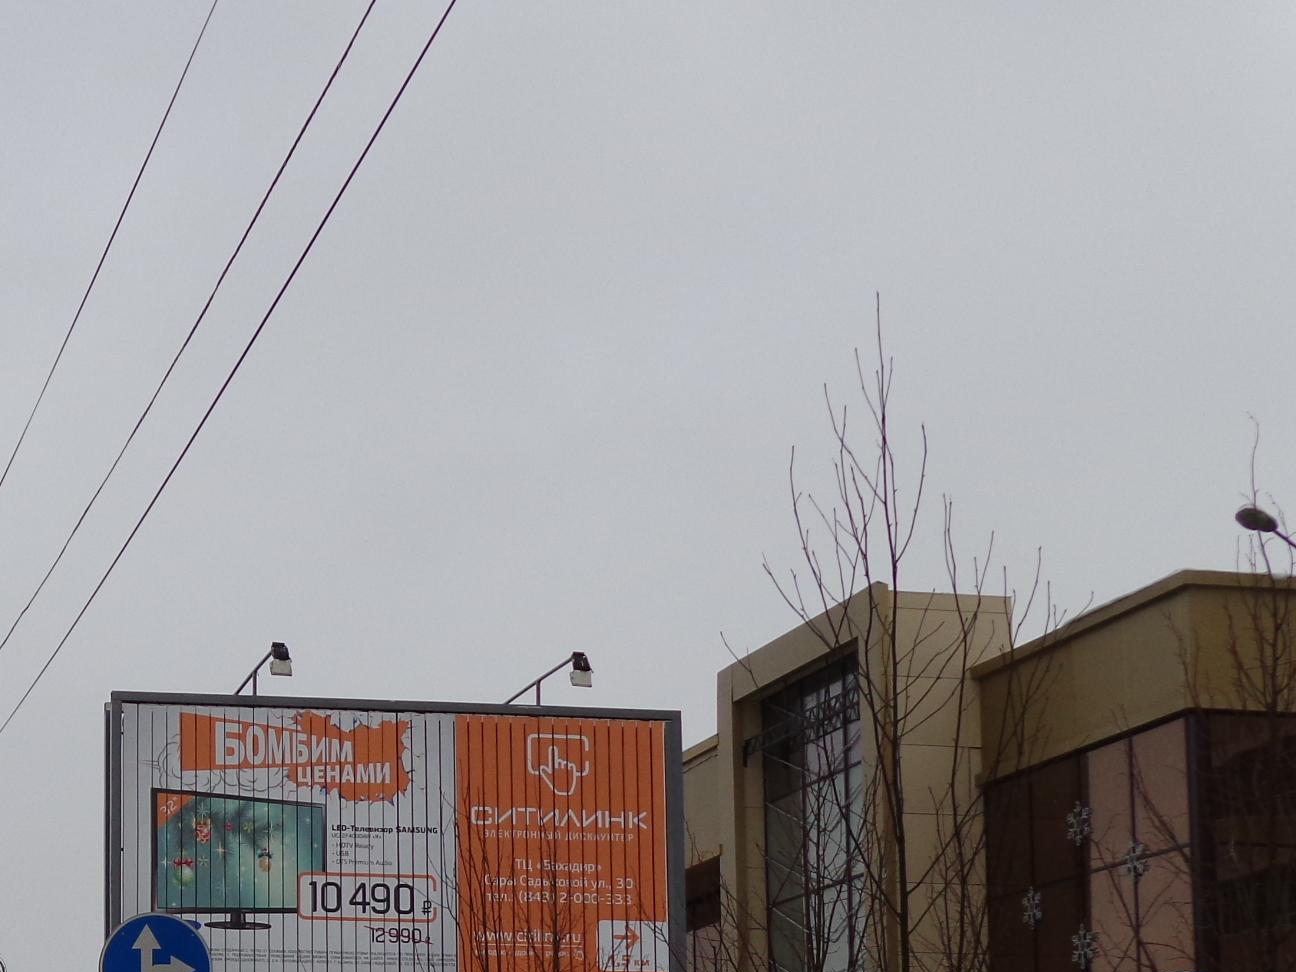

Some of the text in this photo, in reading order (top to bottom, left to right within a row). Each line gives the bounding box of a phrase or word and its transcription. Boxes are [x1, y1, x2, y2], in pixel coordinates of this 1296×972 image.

[215, 721, 353, 766] БОМБИМ
[297, 762, 391, 786] ЦЕНАМИ
[470, 805, 648, 830] СИТИЛИНК
[396, 826, 439, 835] SAMSUNG
[515, 858, 533, 872] ТЦ
[615, 878, 634, 890] 30
